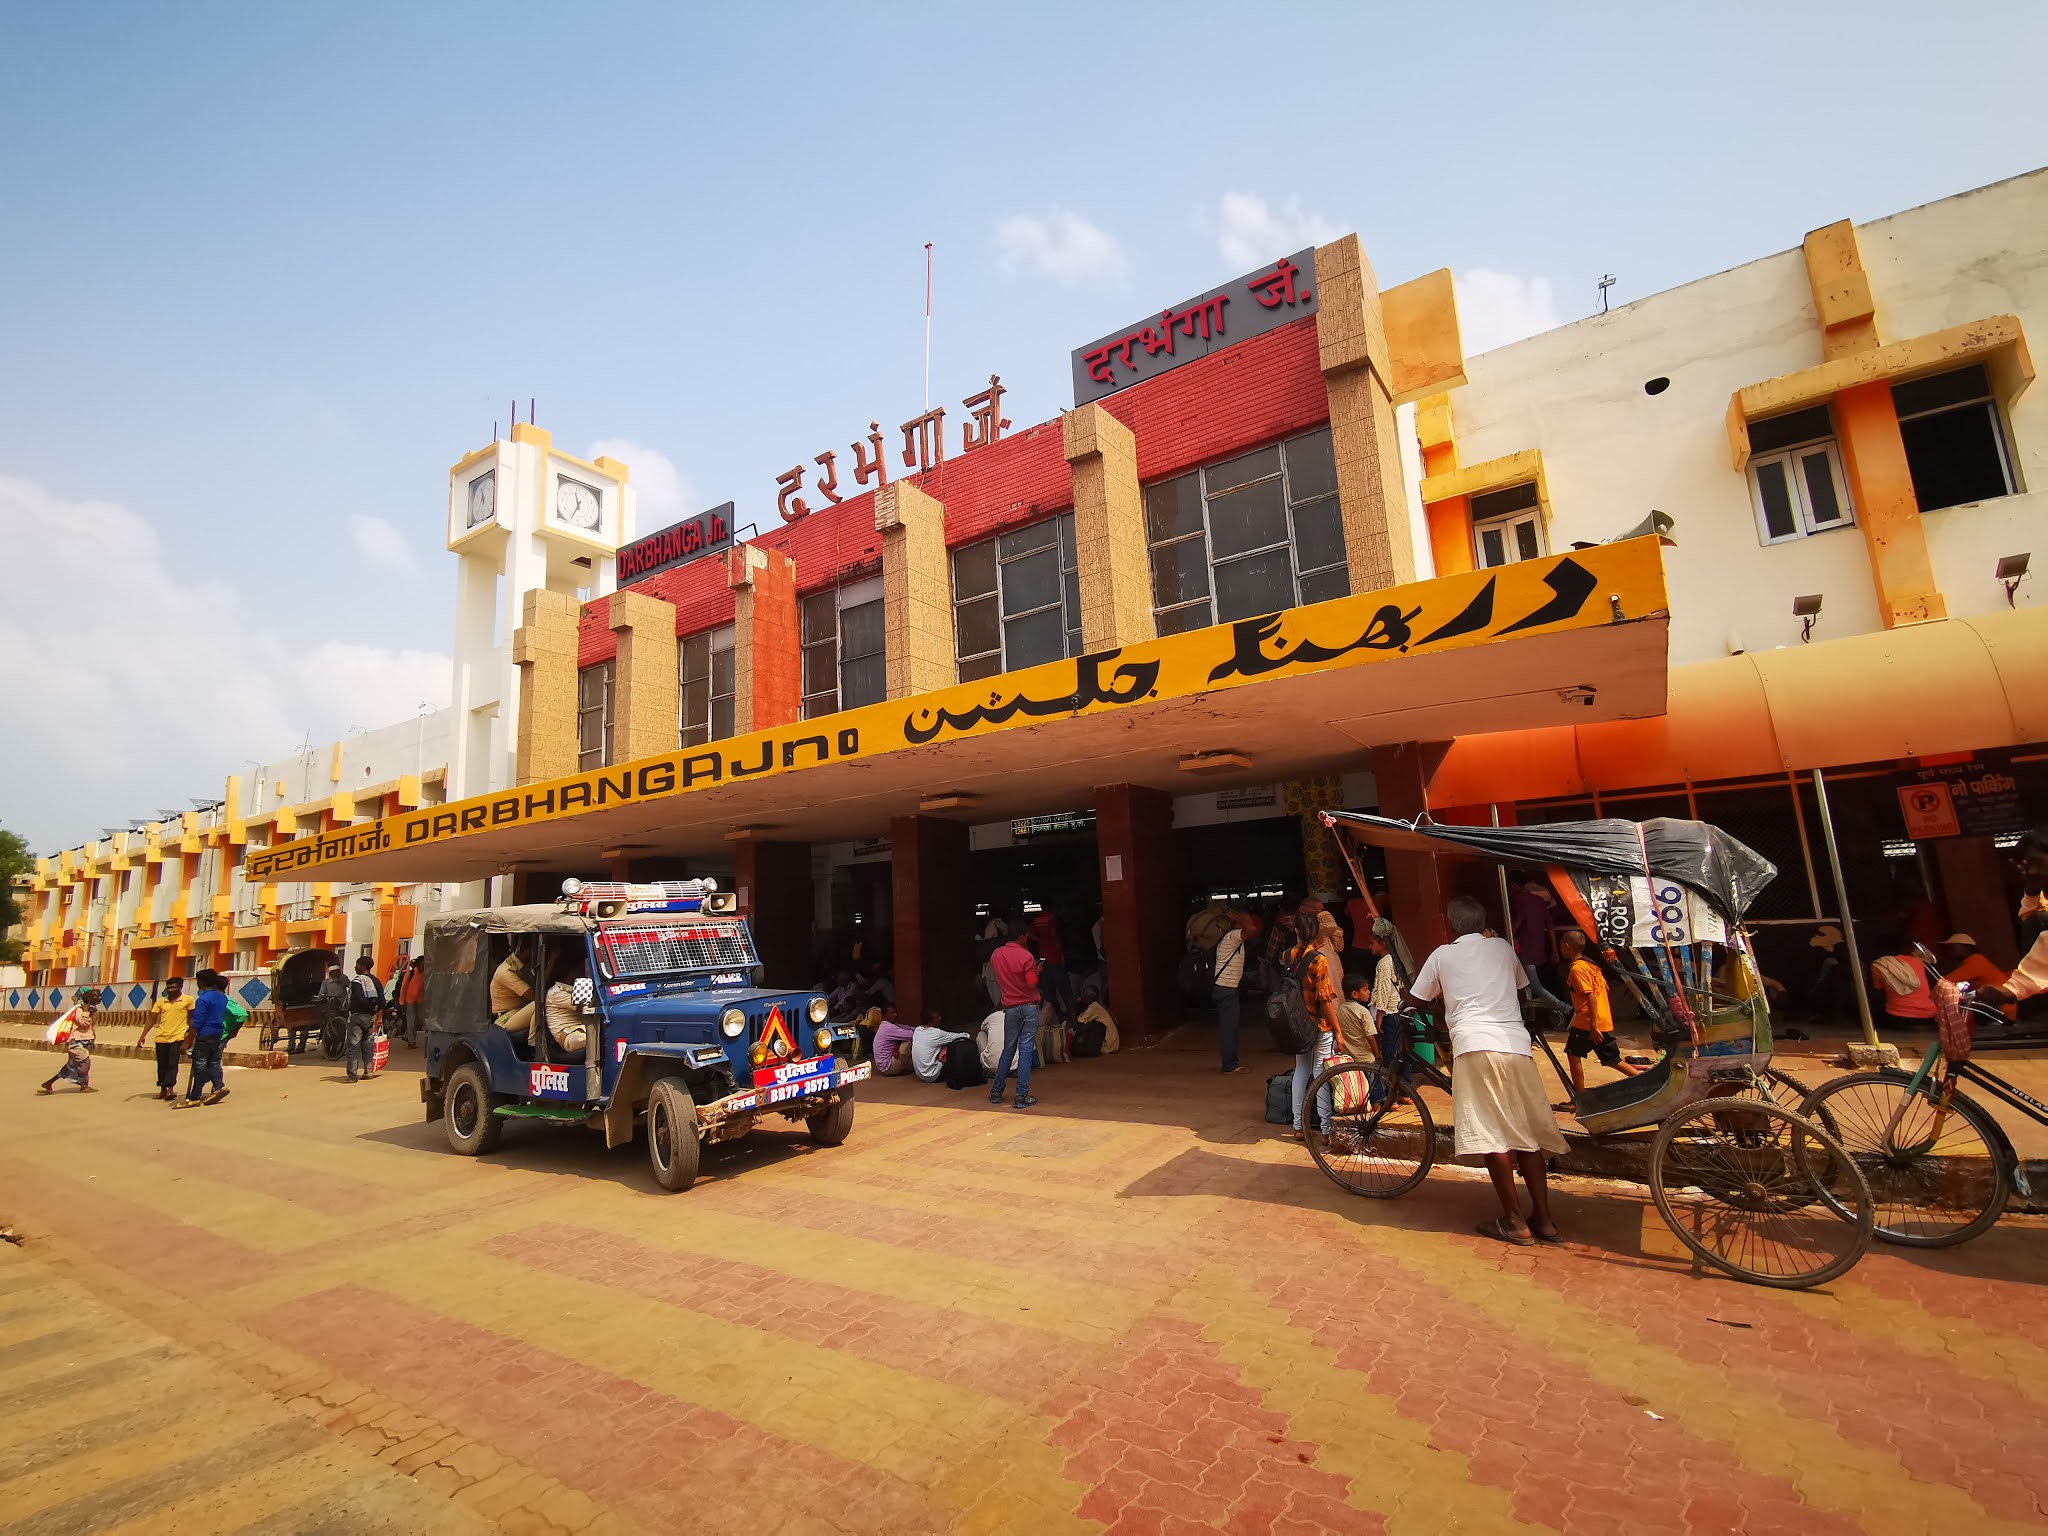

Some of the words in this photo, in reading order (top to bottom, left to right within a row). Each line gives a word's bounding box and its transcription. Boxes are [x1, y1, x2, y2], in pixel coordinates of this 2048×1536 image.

[1081, 309, 1230, 386] दरभंगा
[1248, 257, 1312, 307] जं.
[775, 406, 947, 523] दरभंगा
[617, 519, 703, 580] DARBHANGA
[705, 513, 726, 545] Jn.
[252, 835, 358, 877] दरभंगा
[610, 982, 647, 995] पुलिस
[711, 972, 743, 985] POLICE
[531, 1065, 570, 1097] पुलिस
[774, 1061, 819, 1084] पुलिस
[769, 1083, 800, 1104] BR7P
[803, 1076, 830, 1094] 3573
